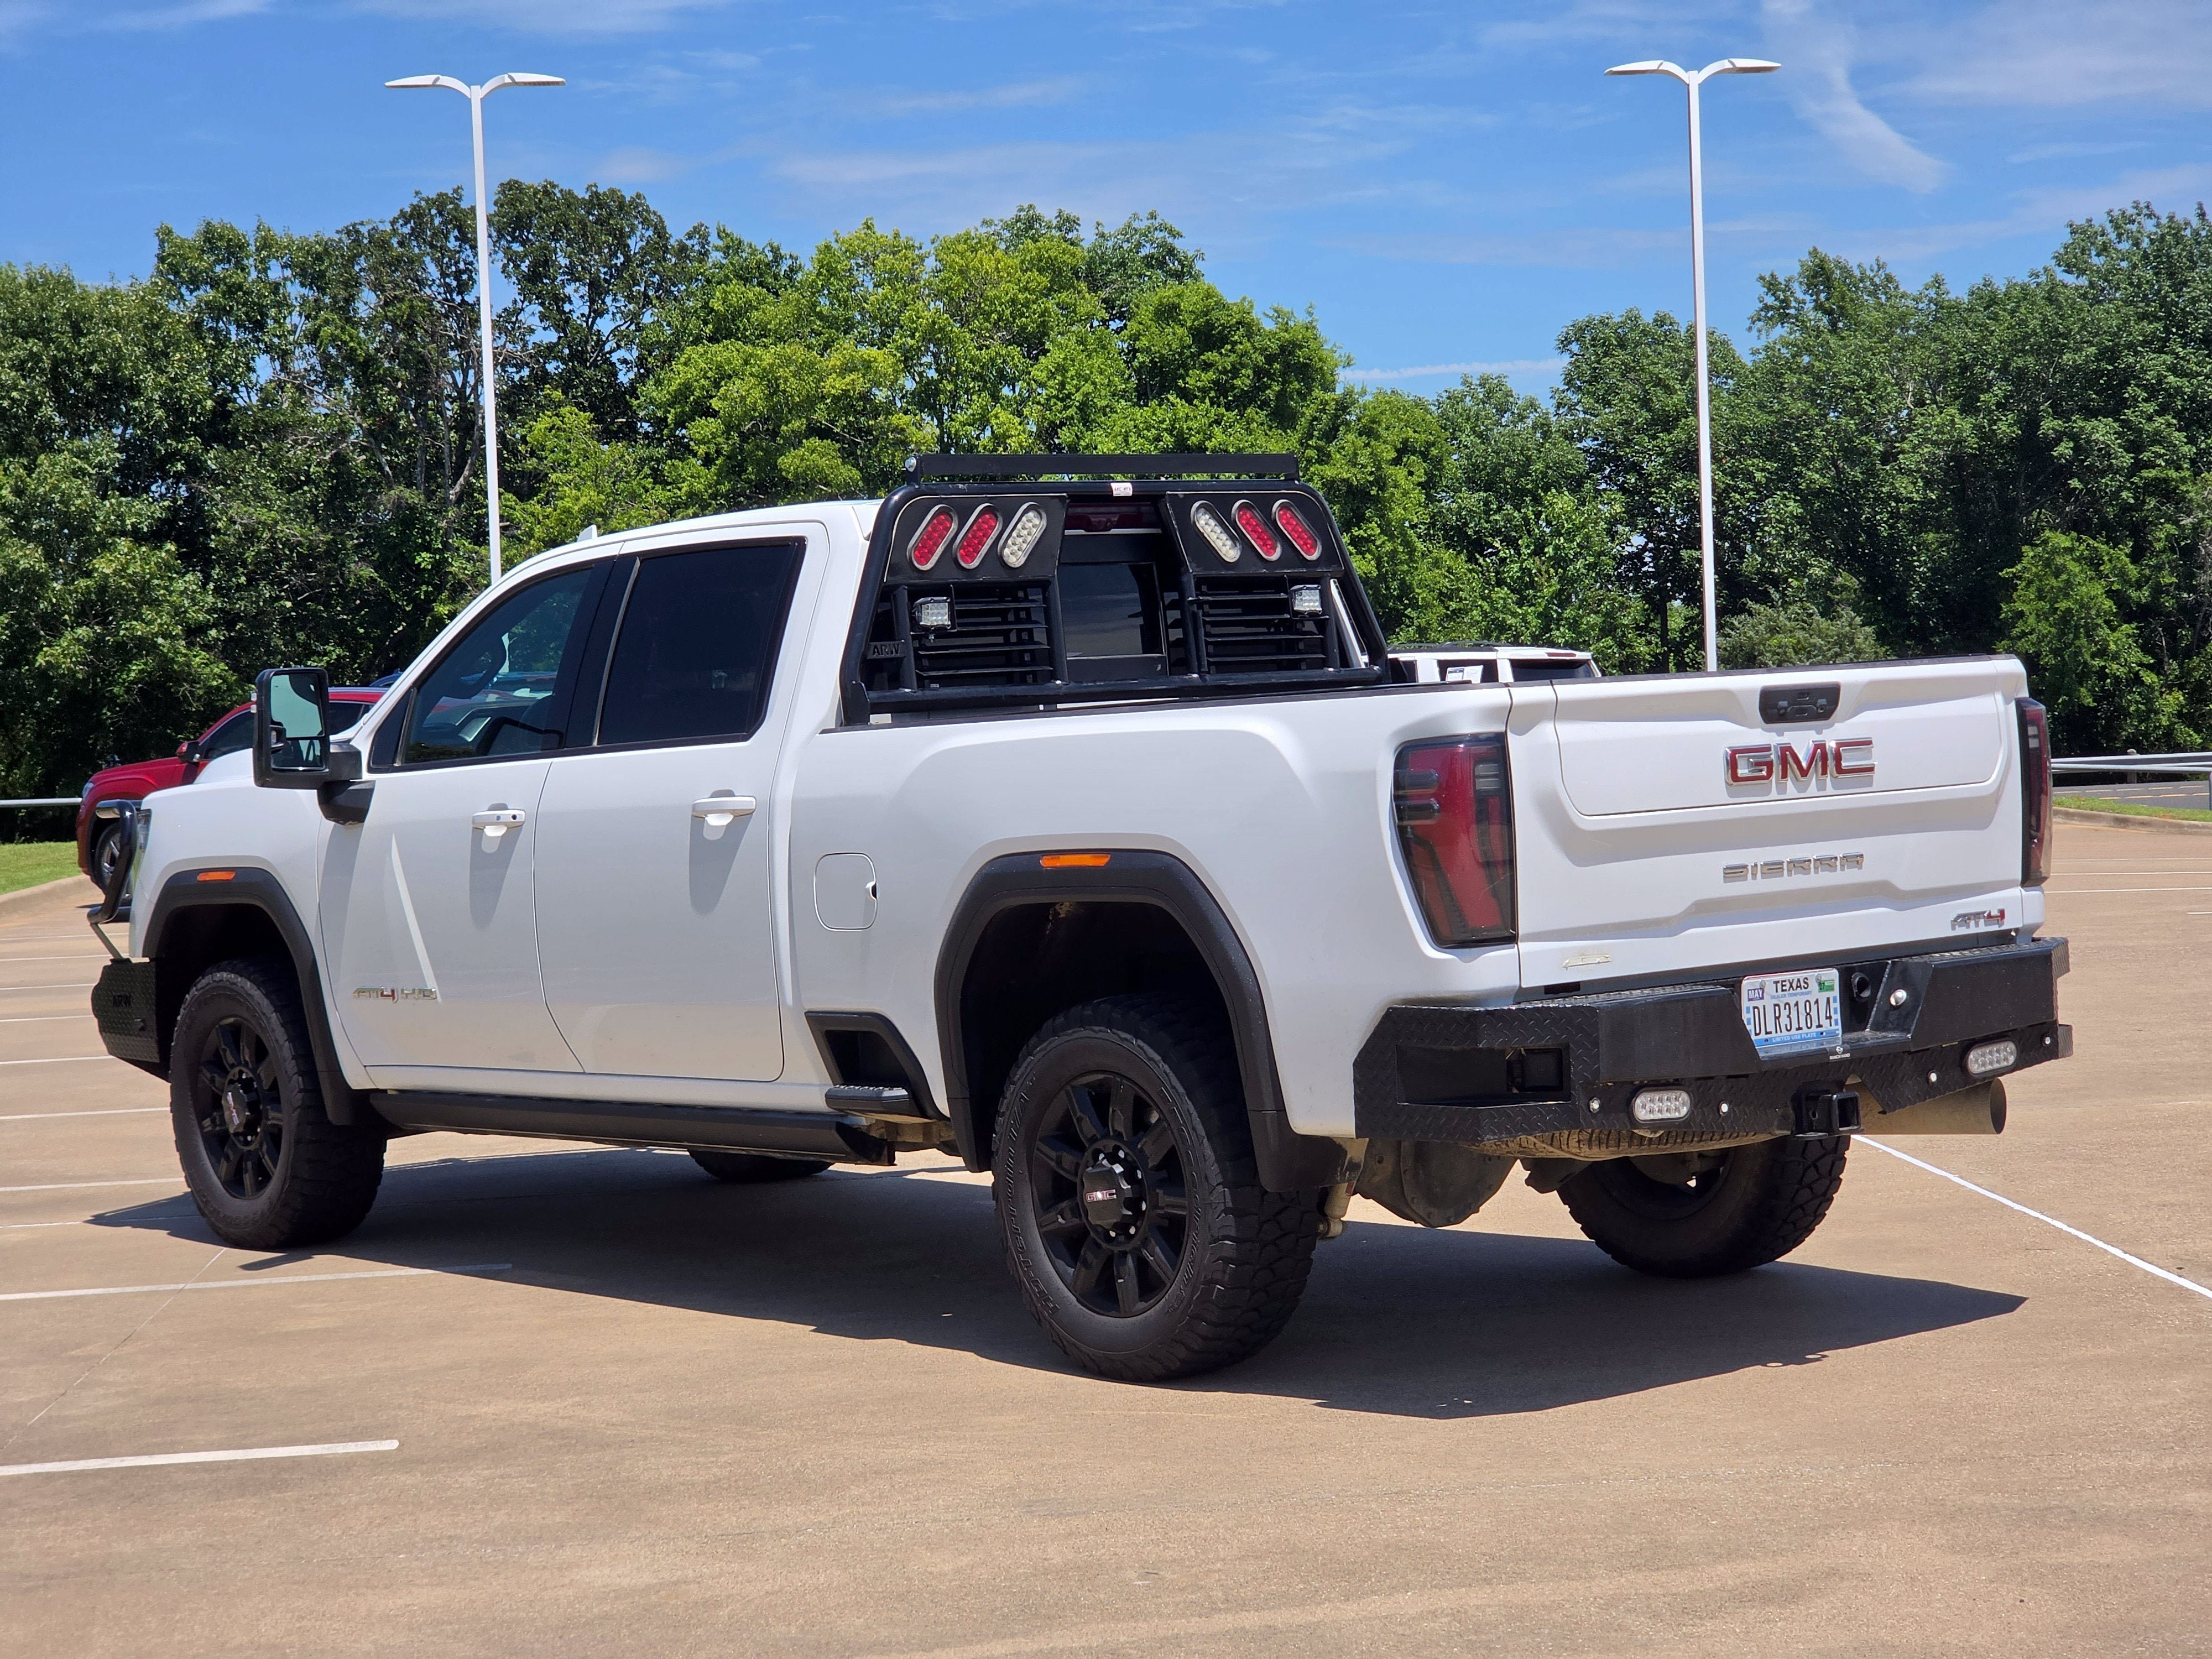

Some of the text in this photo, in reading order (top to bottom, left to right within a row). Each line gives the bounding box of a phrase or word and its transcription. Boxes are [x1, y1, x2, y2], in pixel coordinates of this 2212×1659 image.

[872, 644, 900, 656] ARW
[1724, 737, 1877, 785] GMC
[1723, 852, 1864, 877] SIERRA
[1951, 909, 2005, 925] AT4
[1773, 977, 1809, 993] TEXAS
[351, 987, 436, 1003] AT4 HD
[1749, 989, 1763, 999] MAY
[1752, 997, 1833, 1037] DLR31814
